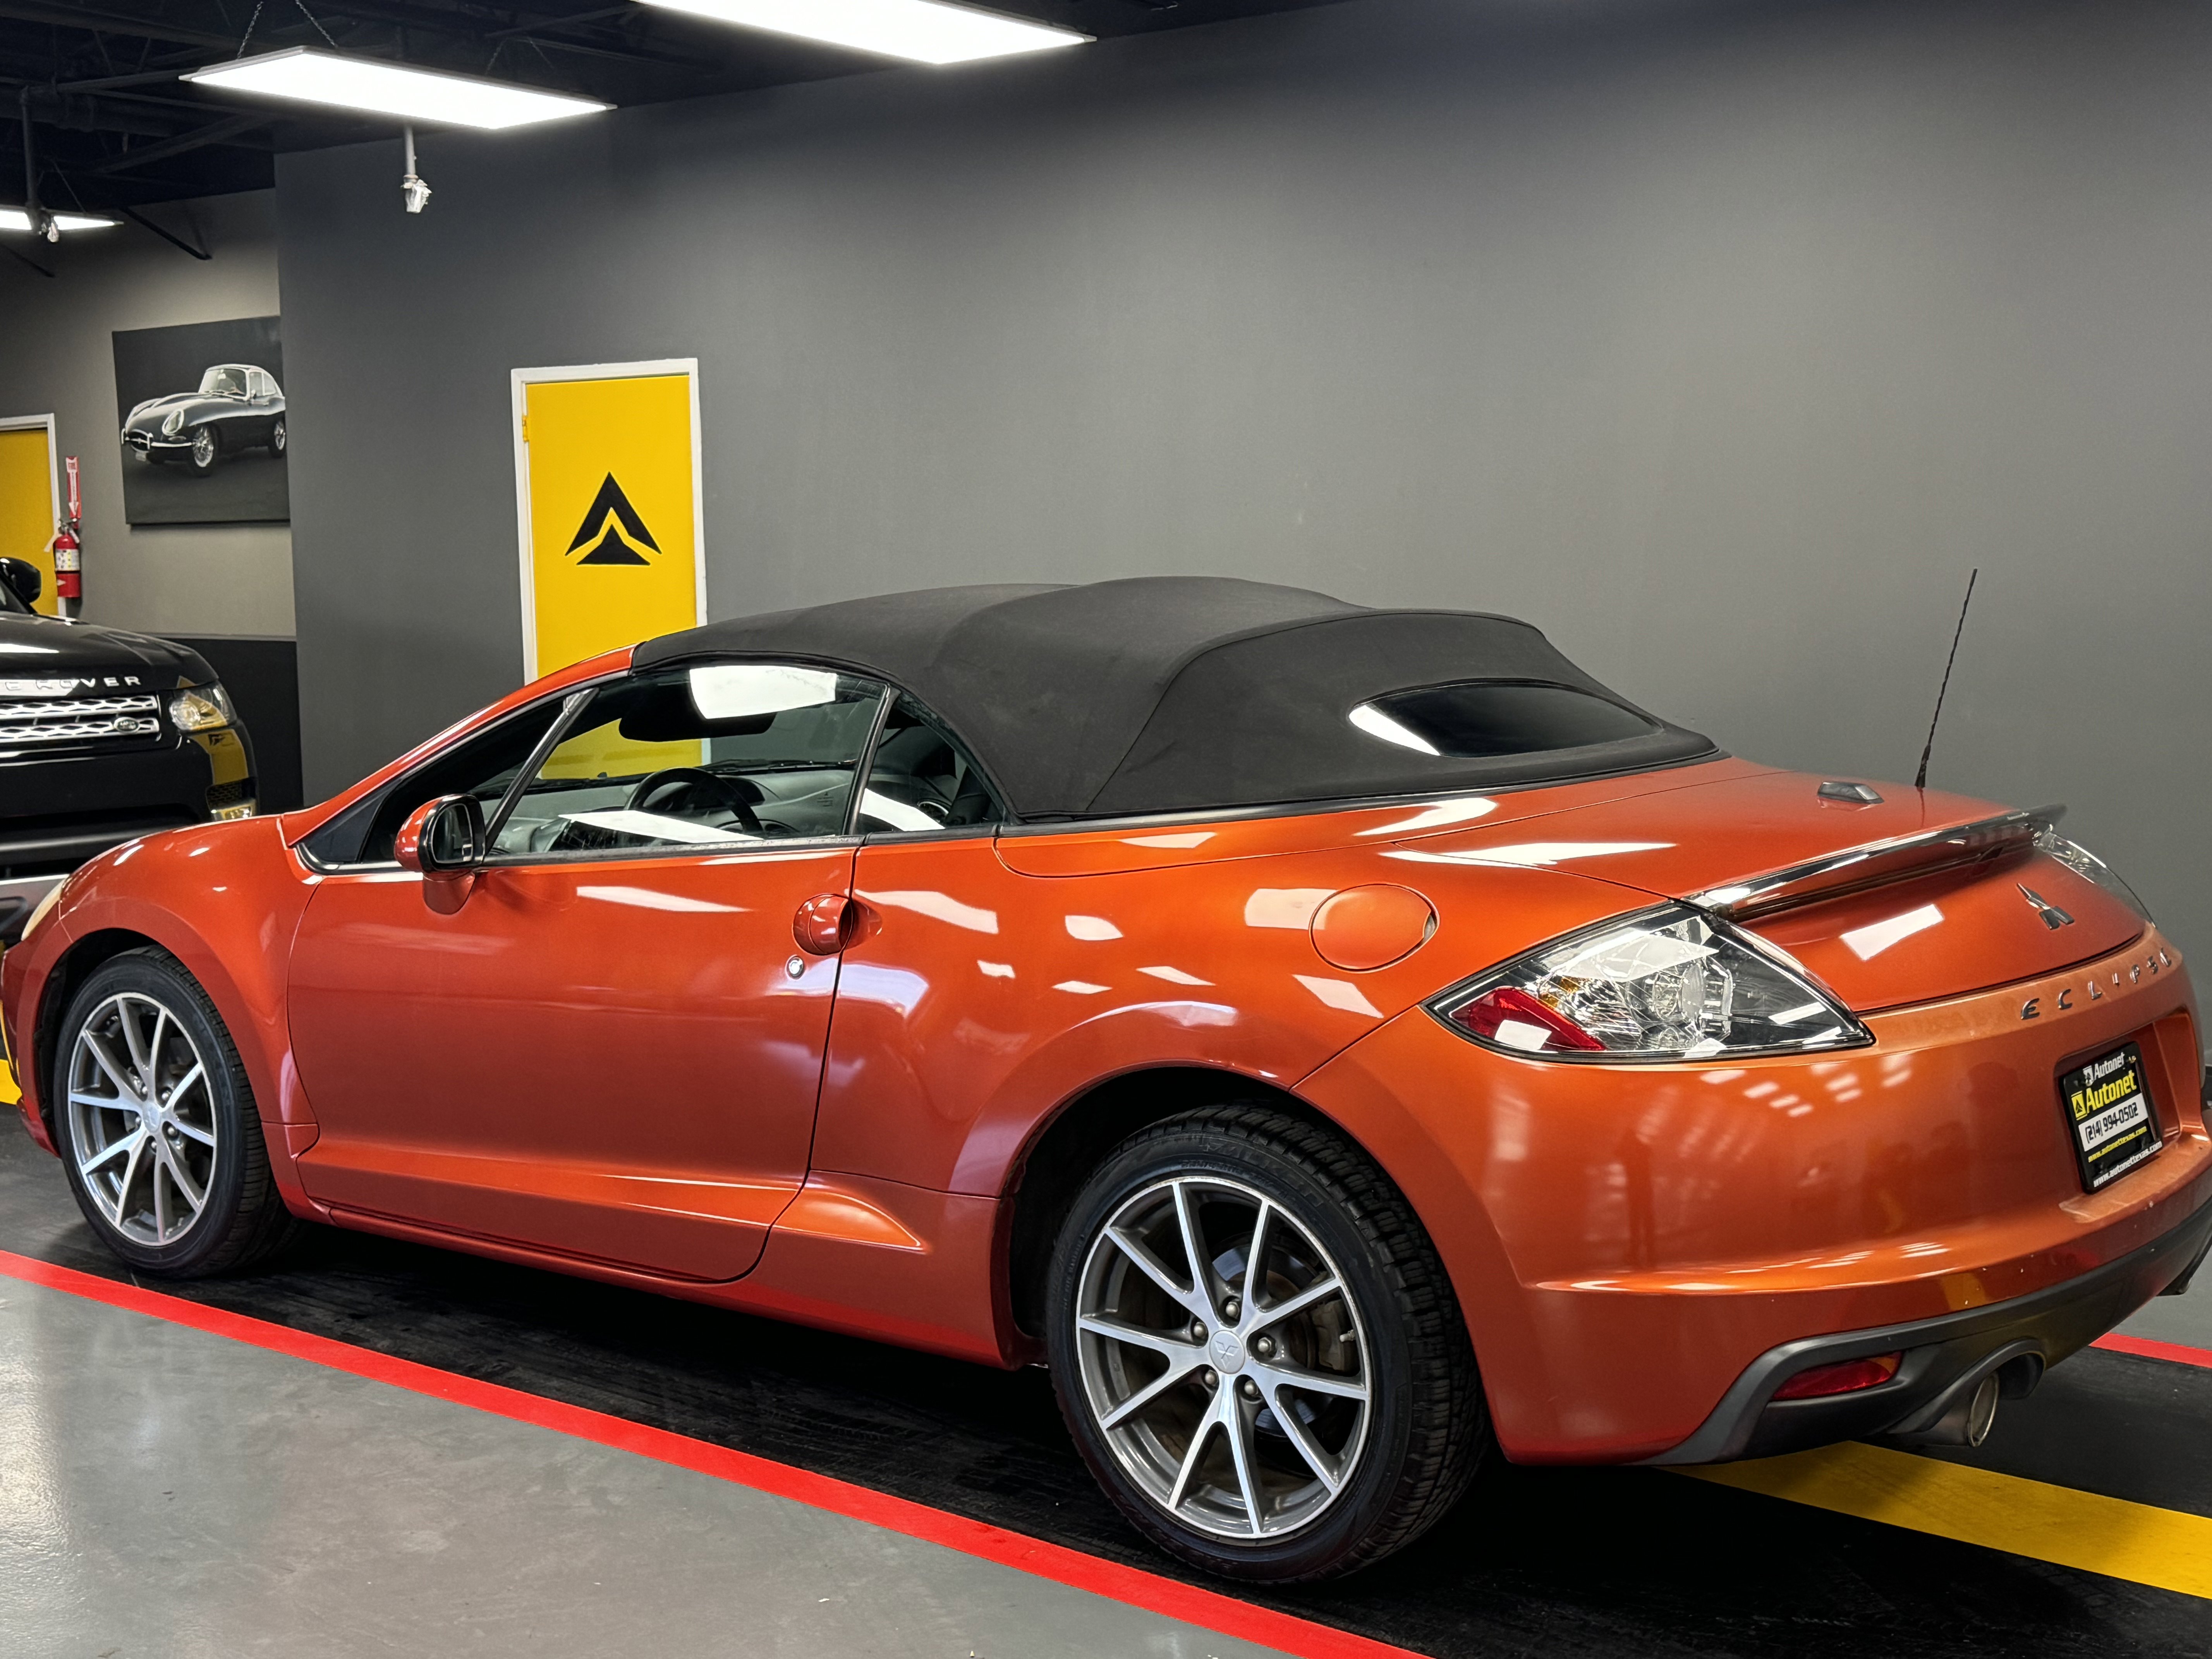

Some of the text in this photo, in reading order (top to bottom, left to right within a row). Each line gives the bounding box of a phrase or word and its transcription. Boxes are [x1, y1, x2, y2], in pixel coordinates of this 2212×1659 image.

[36, 676, 141, 689] ROVER
[2021, 948, 2171, 1020] ECLIPSE
[2094, 1052, 2125, 1080] Autonet
[2087, 1070, 2137, 1114] Autonet
[2085, 1102, 2138, 1144] (214) 994-0502
[2088, 1126, 2147, 1163] www.autonettexas.com
[2094, 1141, 2162, 1187] www.autonettexas.com
